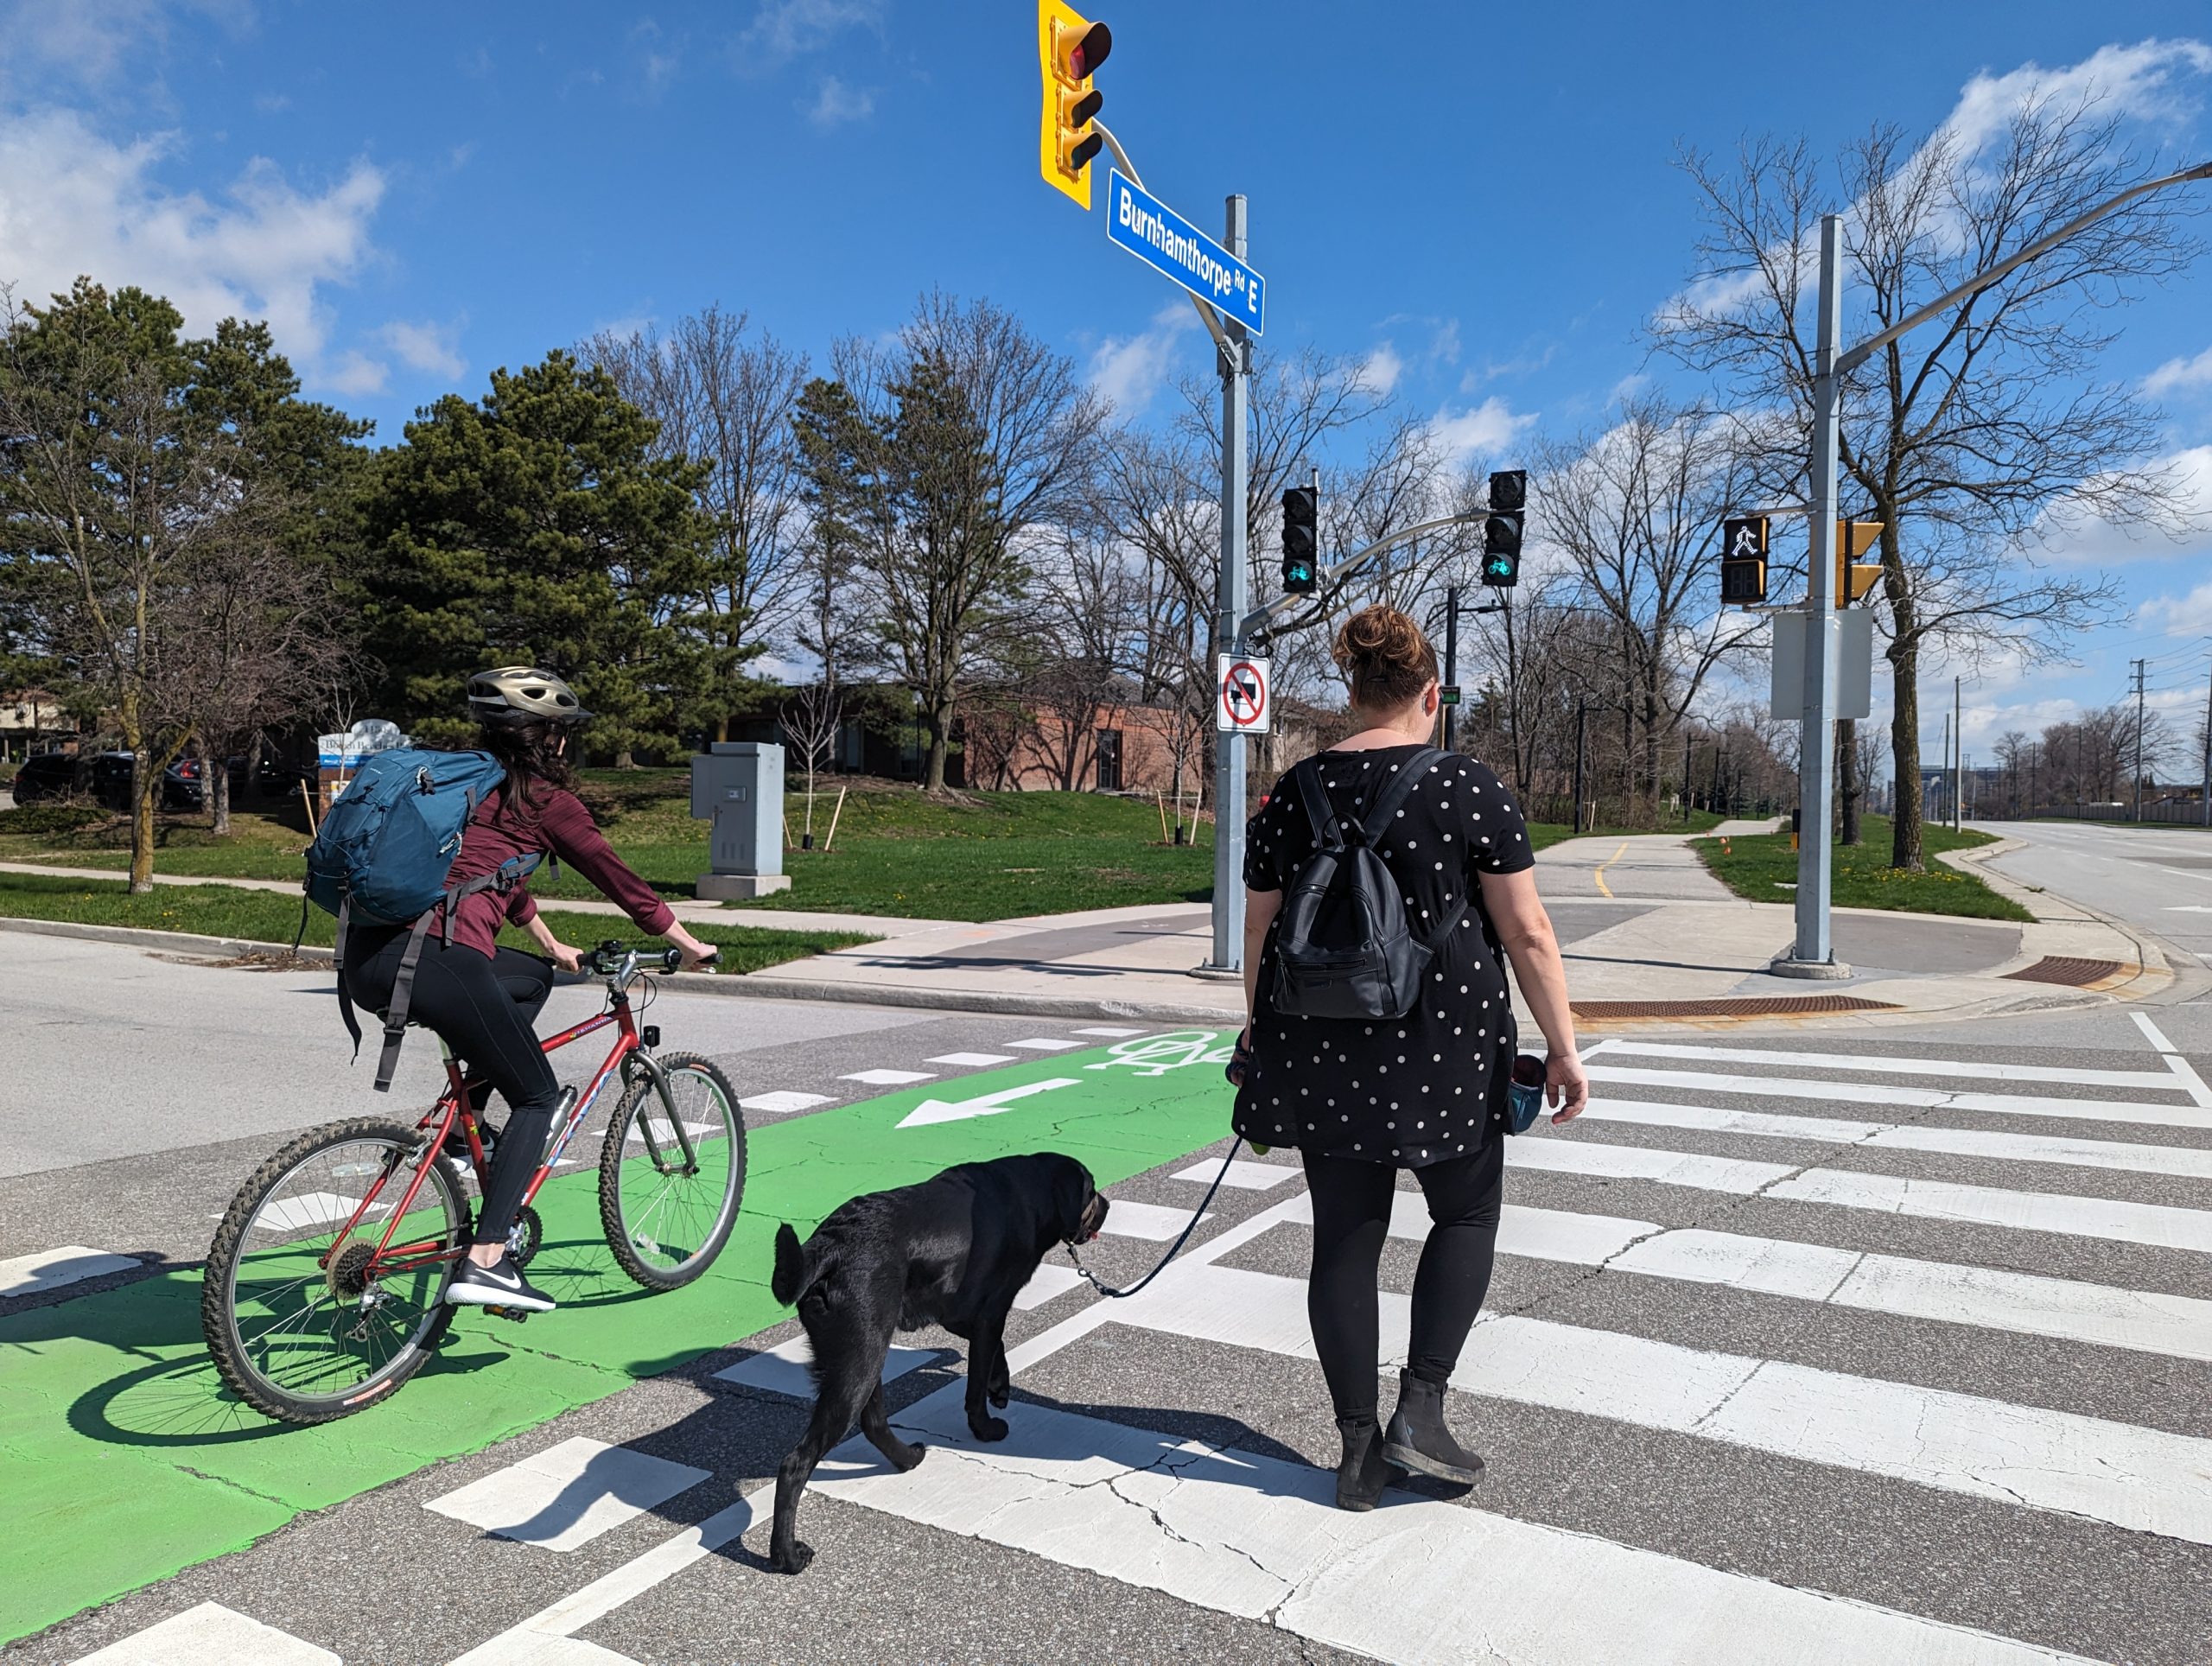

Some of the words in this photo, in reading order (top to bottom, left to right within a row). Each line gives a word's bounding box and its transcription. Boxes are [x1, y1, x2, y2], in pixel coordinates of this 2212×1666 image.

[1119, 186, 1231, 297] Burnhamthorpe
[1234, 269, 1245, 292] Rd
[1248, 279, 1258, 314] E
